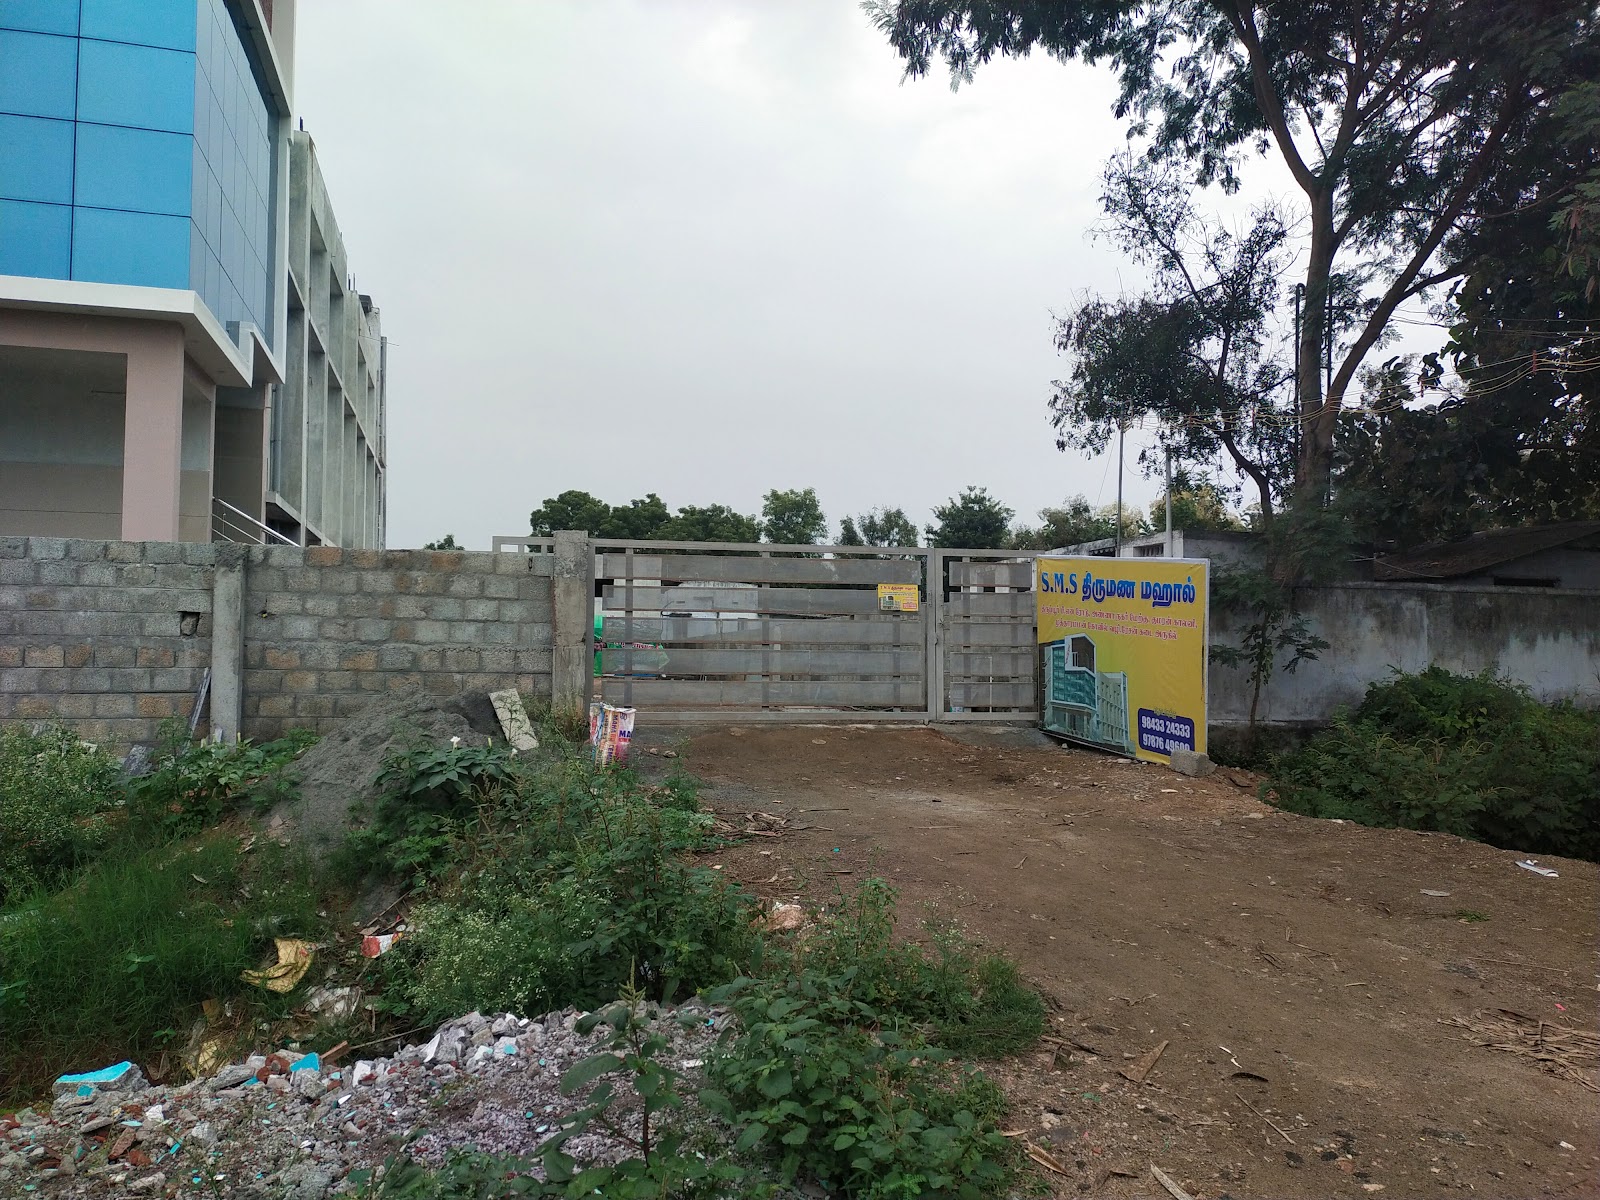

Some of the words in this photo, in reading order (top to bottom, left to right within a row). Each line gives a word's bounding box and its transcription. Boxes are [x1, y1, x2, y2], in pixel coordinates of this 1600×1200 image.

[1041, 571, 1078, 594] S.M.S
[1082, 571, 1136, 603] திருமண
[1140, 575, 1196, 608] மஹால்
[1141, 715, 1165, 733] 98433
[1165, 721, 1191, 738] 24333
[1142, 733, 1165, 750] 97876
